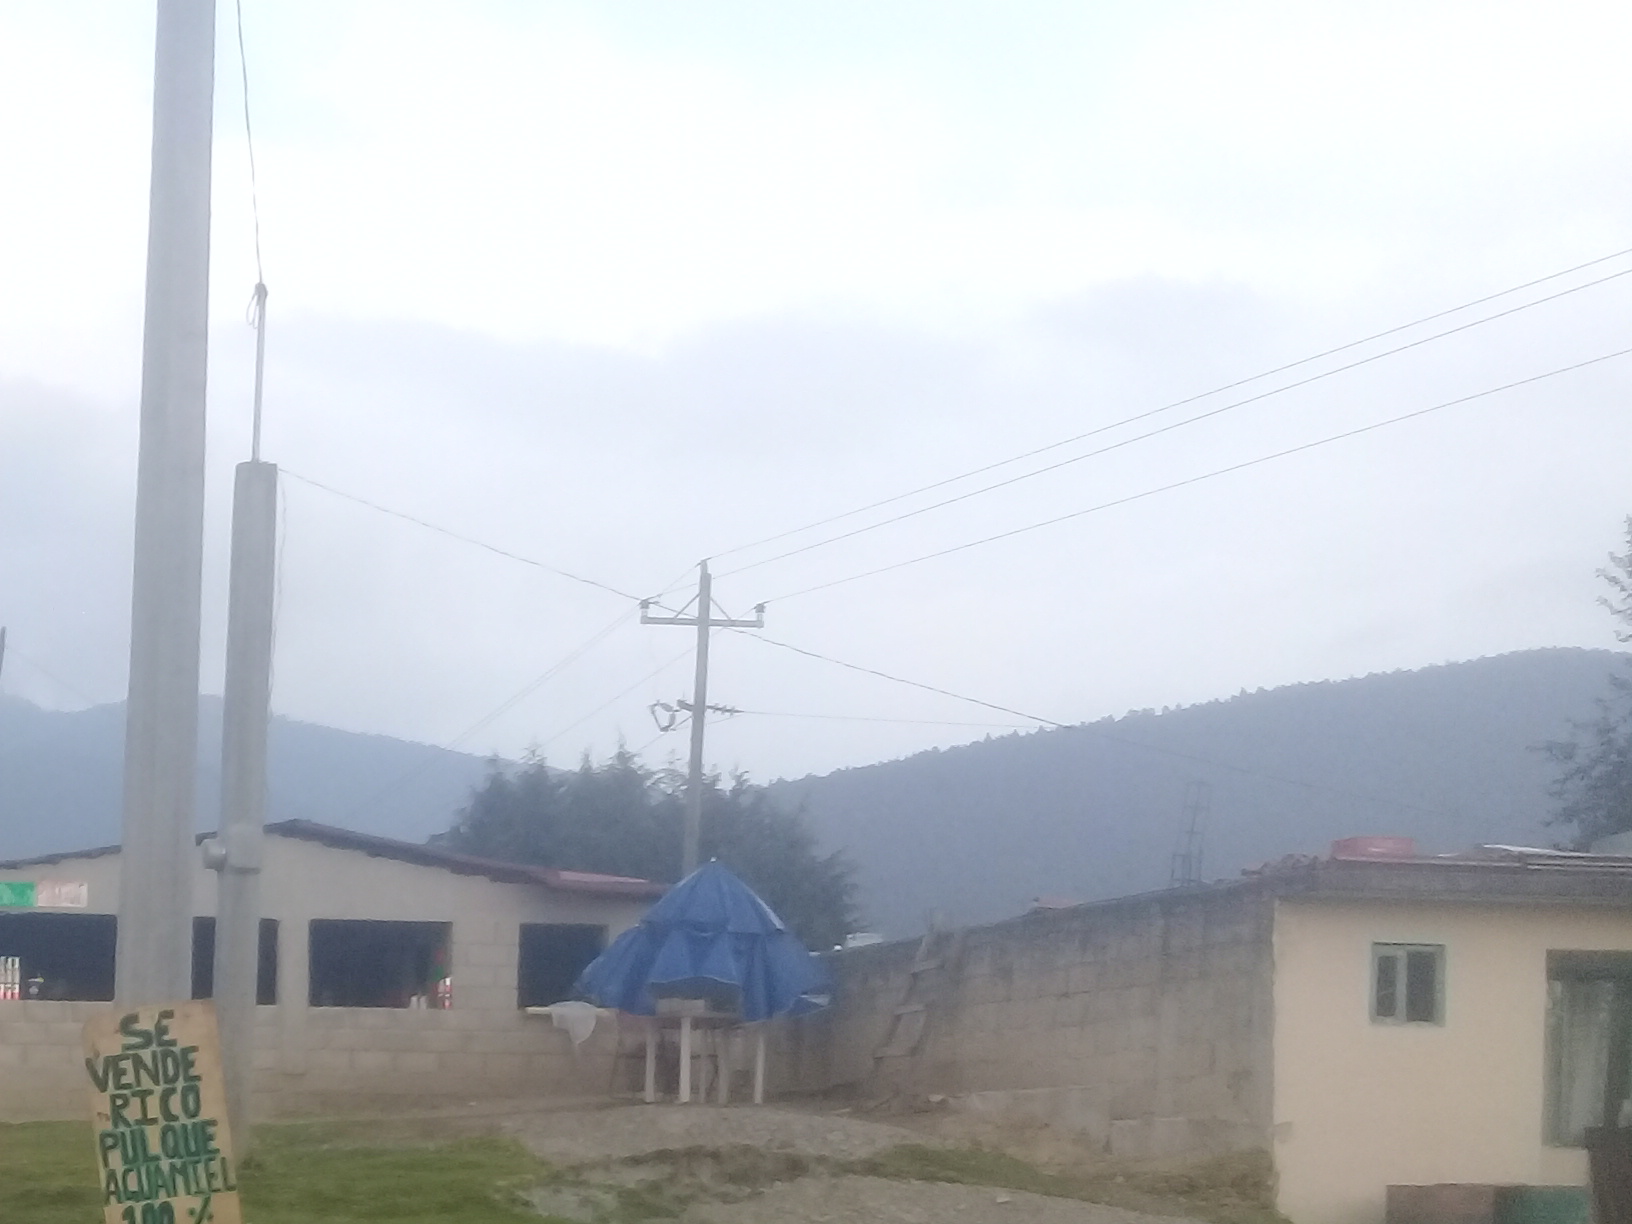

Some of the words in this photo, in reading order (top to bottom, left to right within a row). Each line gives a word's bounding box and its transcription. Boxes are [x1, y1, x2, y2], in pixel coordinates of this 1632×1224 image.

[120, 1009, 177, 1051] SE
[85, 1046, 201, 1092] VENDE
[109, 1084, 201, 1128] RICO
[99, 1119, 220, 1168] PULQUE
